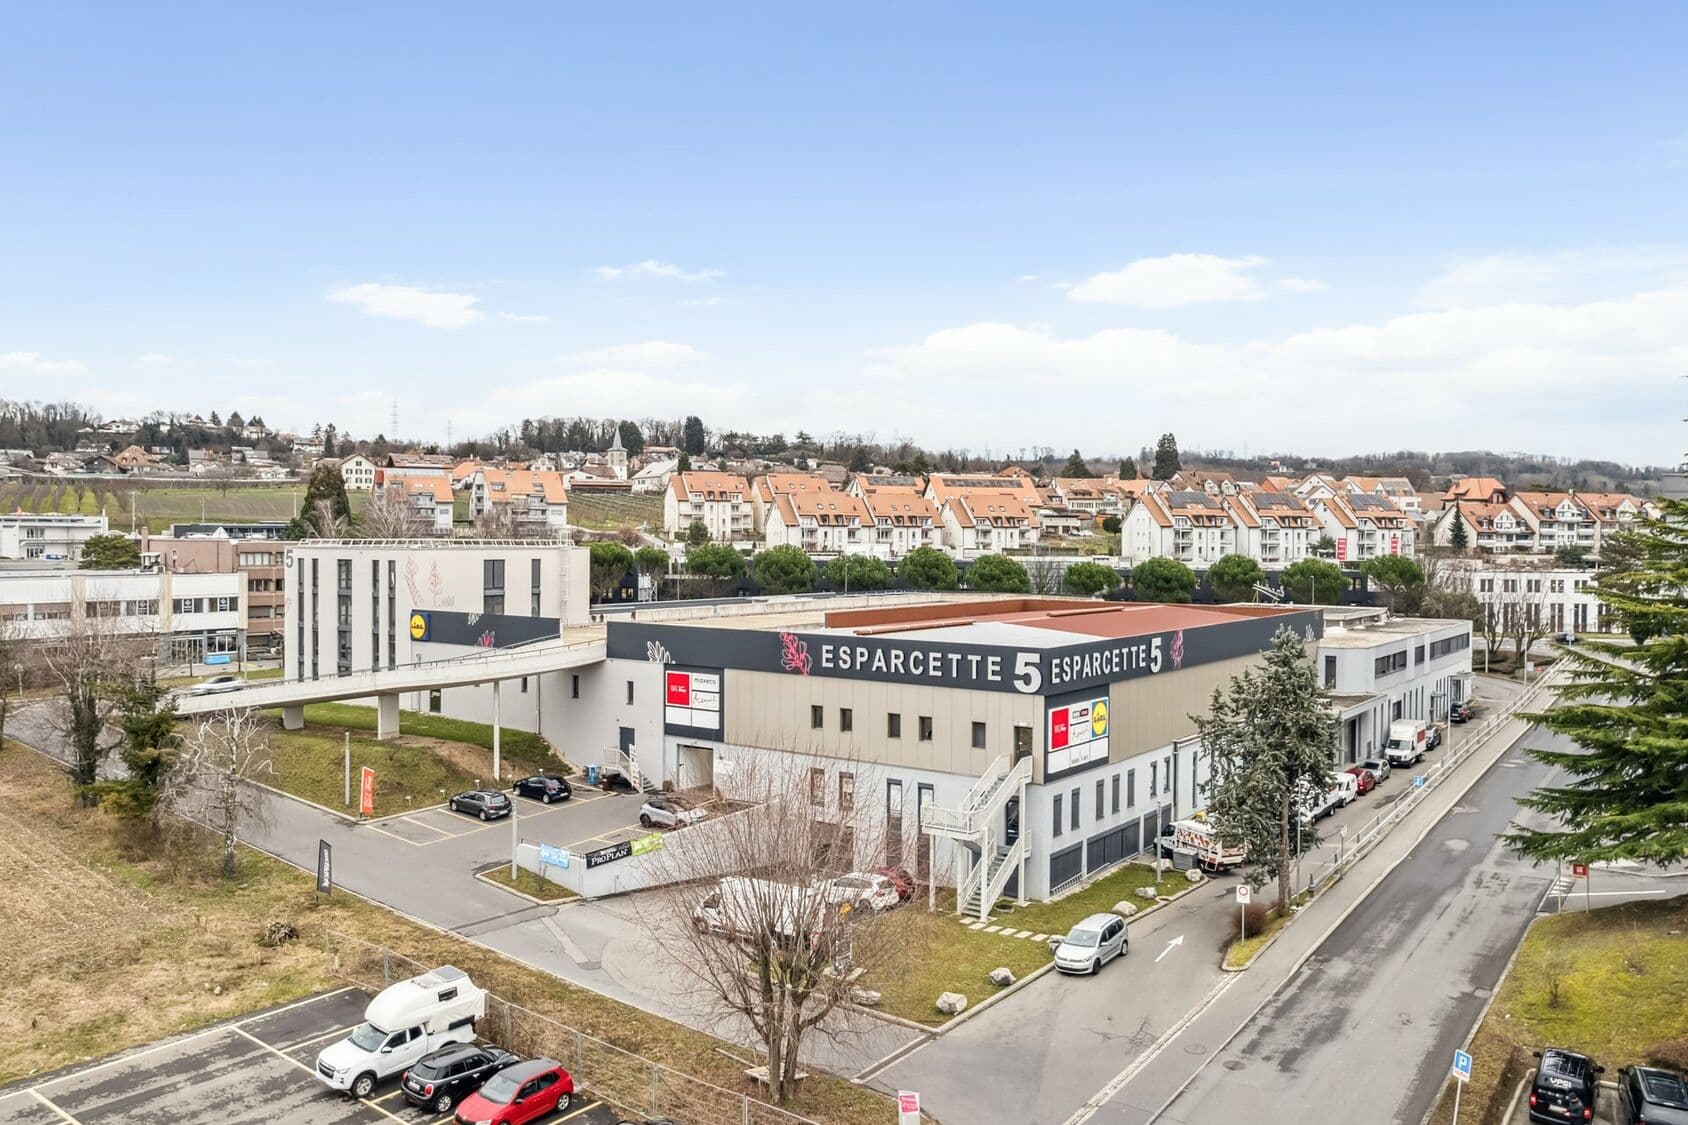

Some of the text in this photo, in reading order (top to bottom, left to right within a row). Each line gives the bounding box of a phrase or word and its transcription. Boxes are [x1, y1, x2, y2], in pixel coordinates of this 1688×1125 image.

[286, 549, 294, 568] 5
[821, 644, 1042, 694] ESPARCETTE 5
[1051, 637, 1162, 684] ESPARCETTE 5
[1459, 1055, 1467, 1068] P
